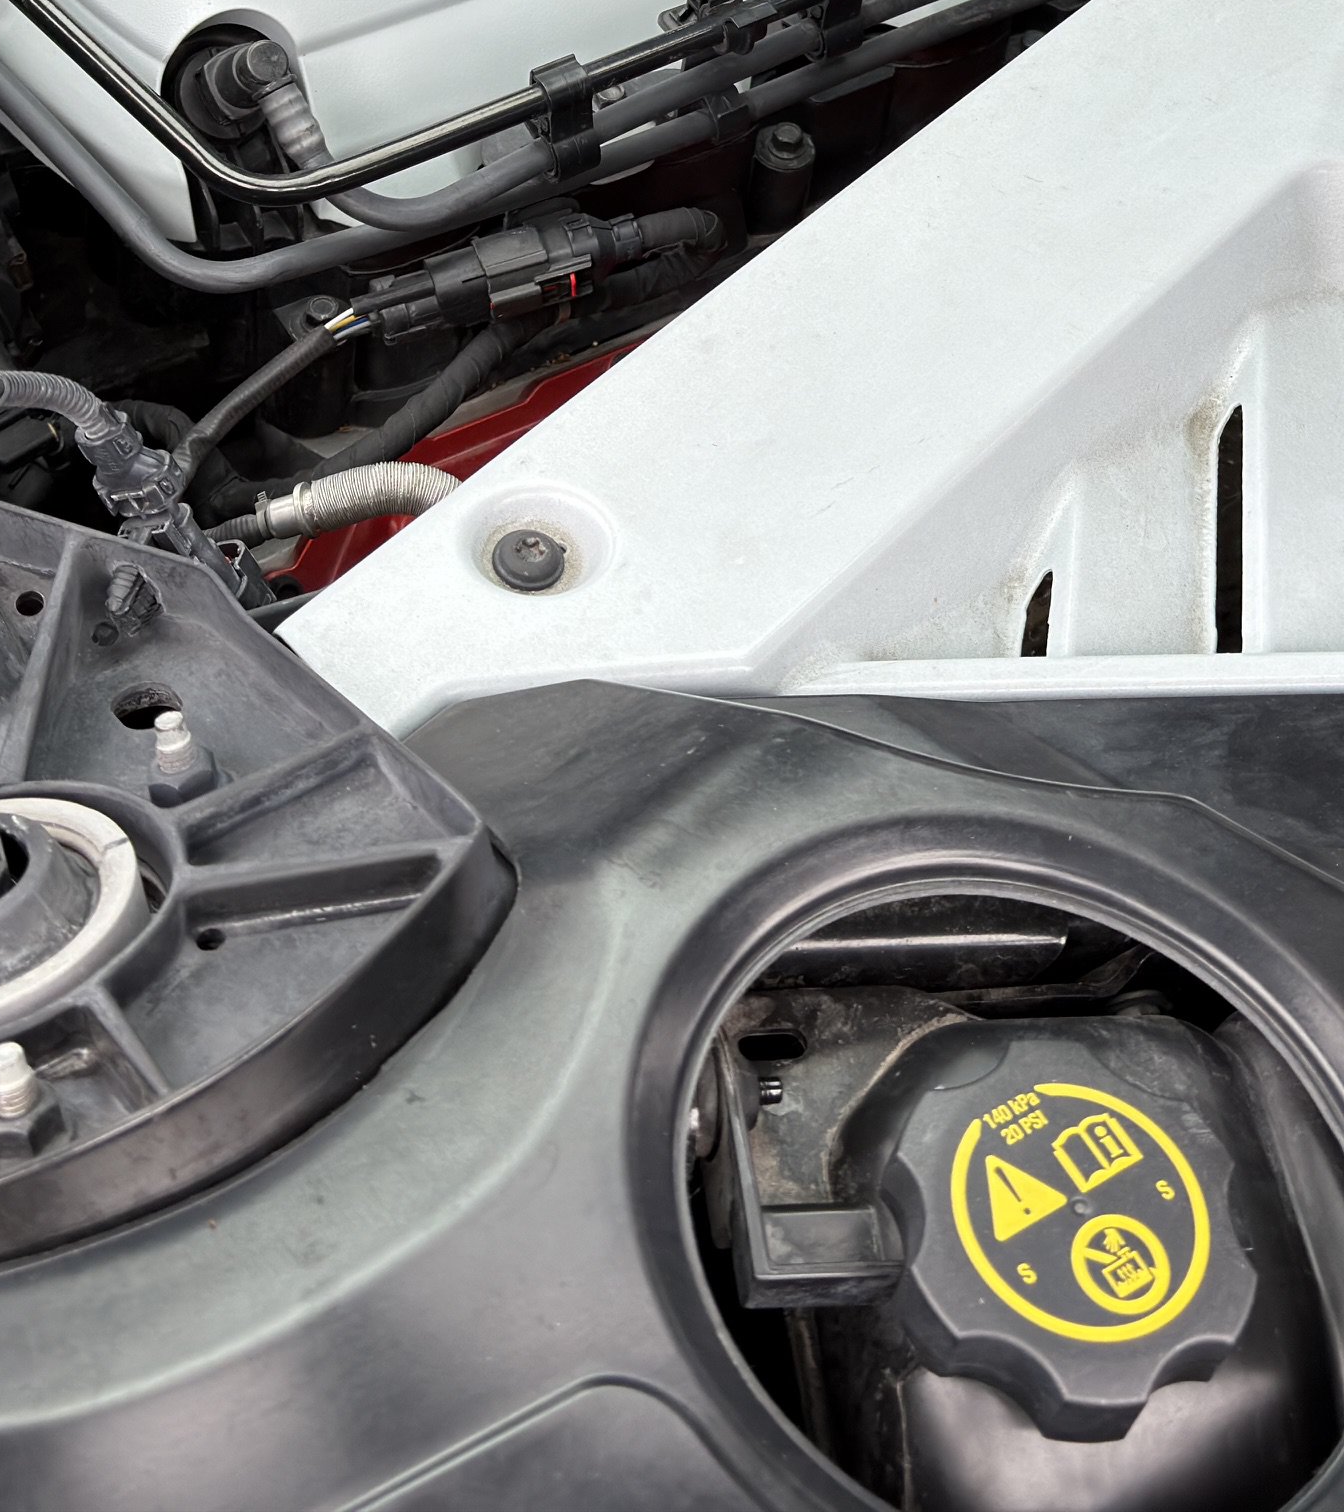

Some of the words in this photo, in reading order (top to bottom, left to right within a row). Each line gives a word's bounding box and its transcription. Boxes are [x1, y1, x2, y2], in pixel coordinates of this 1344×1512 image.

[982, 1103, 1014, 1129] 140
[1007, 1092, 1041, 1115] kPa
[1000, 1124, 1025, 1146] 20
[1018, 1109, 1049, 1135] PSI
